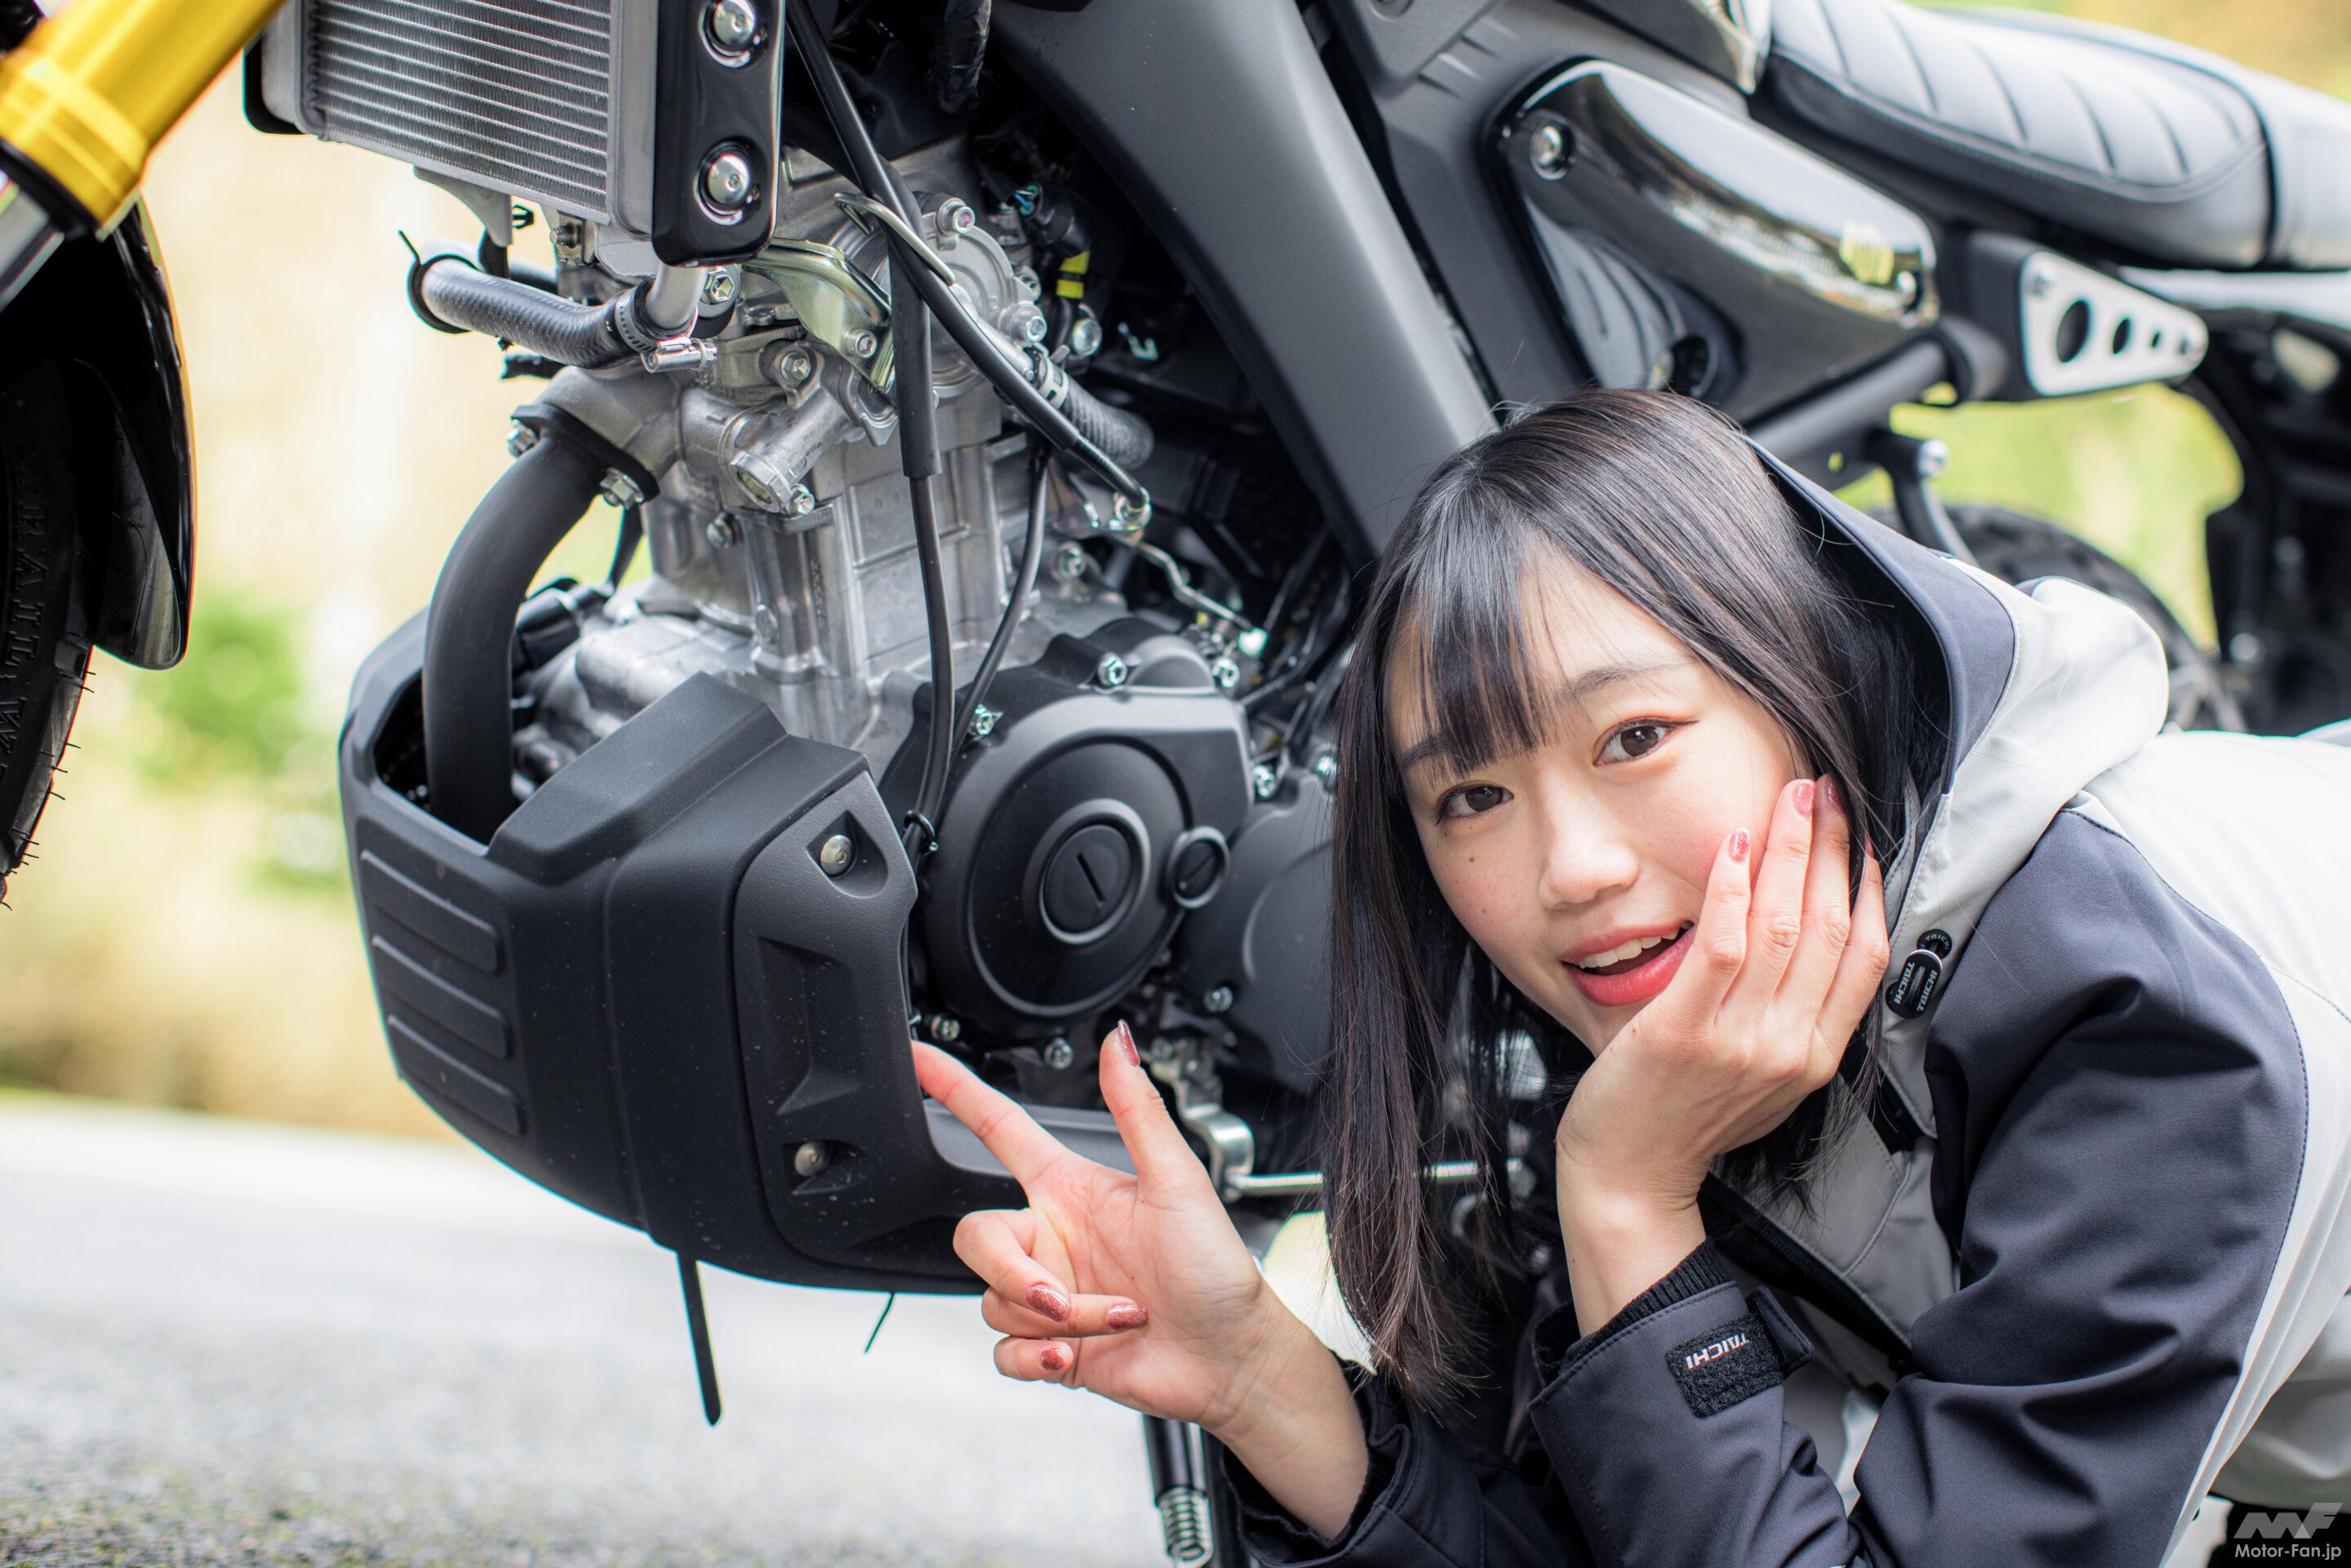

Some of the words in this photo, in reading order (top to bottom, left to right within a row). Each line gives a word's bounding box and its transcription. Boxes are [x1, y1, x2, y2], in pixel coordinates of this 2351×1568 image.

[1925, 934, 1950, 950] TAICHI
[1894, 962, 1915, 1005] TAICHI
[1917, 970, 1938, 1011] TAICHI
[1686, 1332, 1750, 1371] TAICHI
